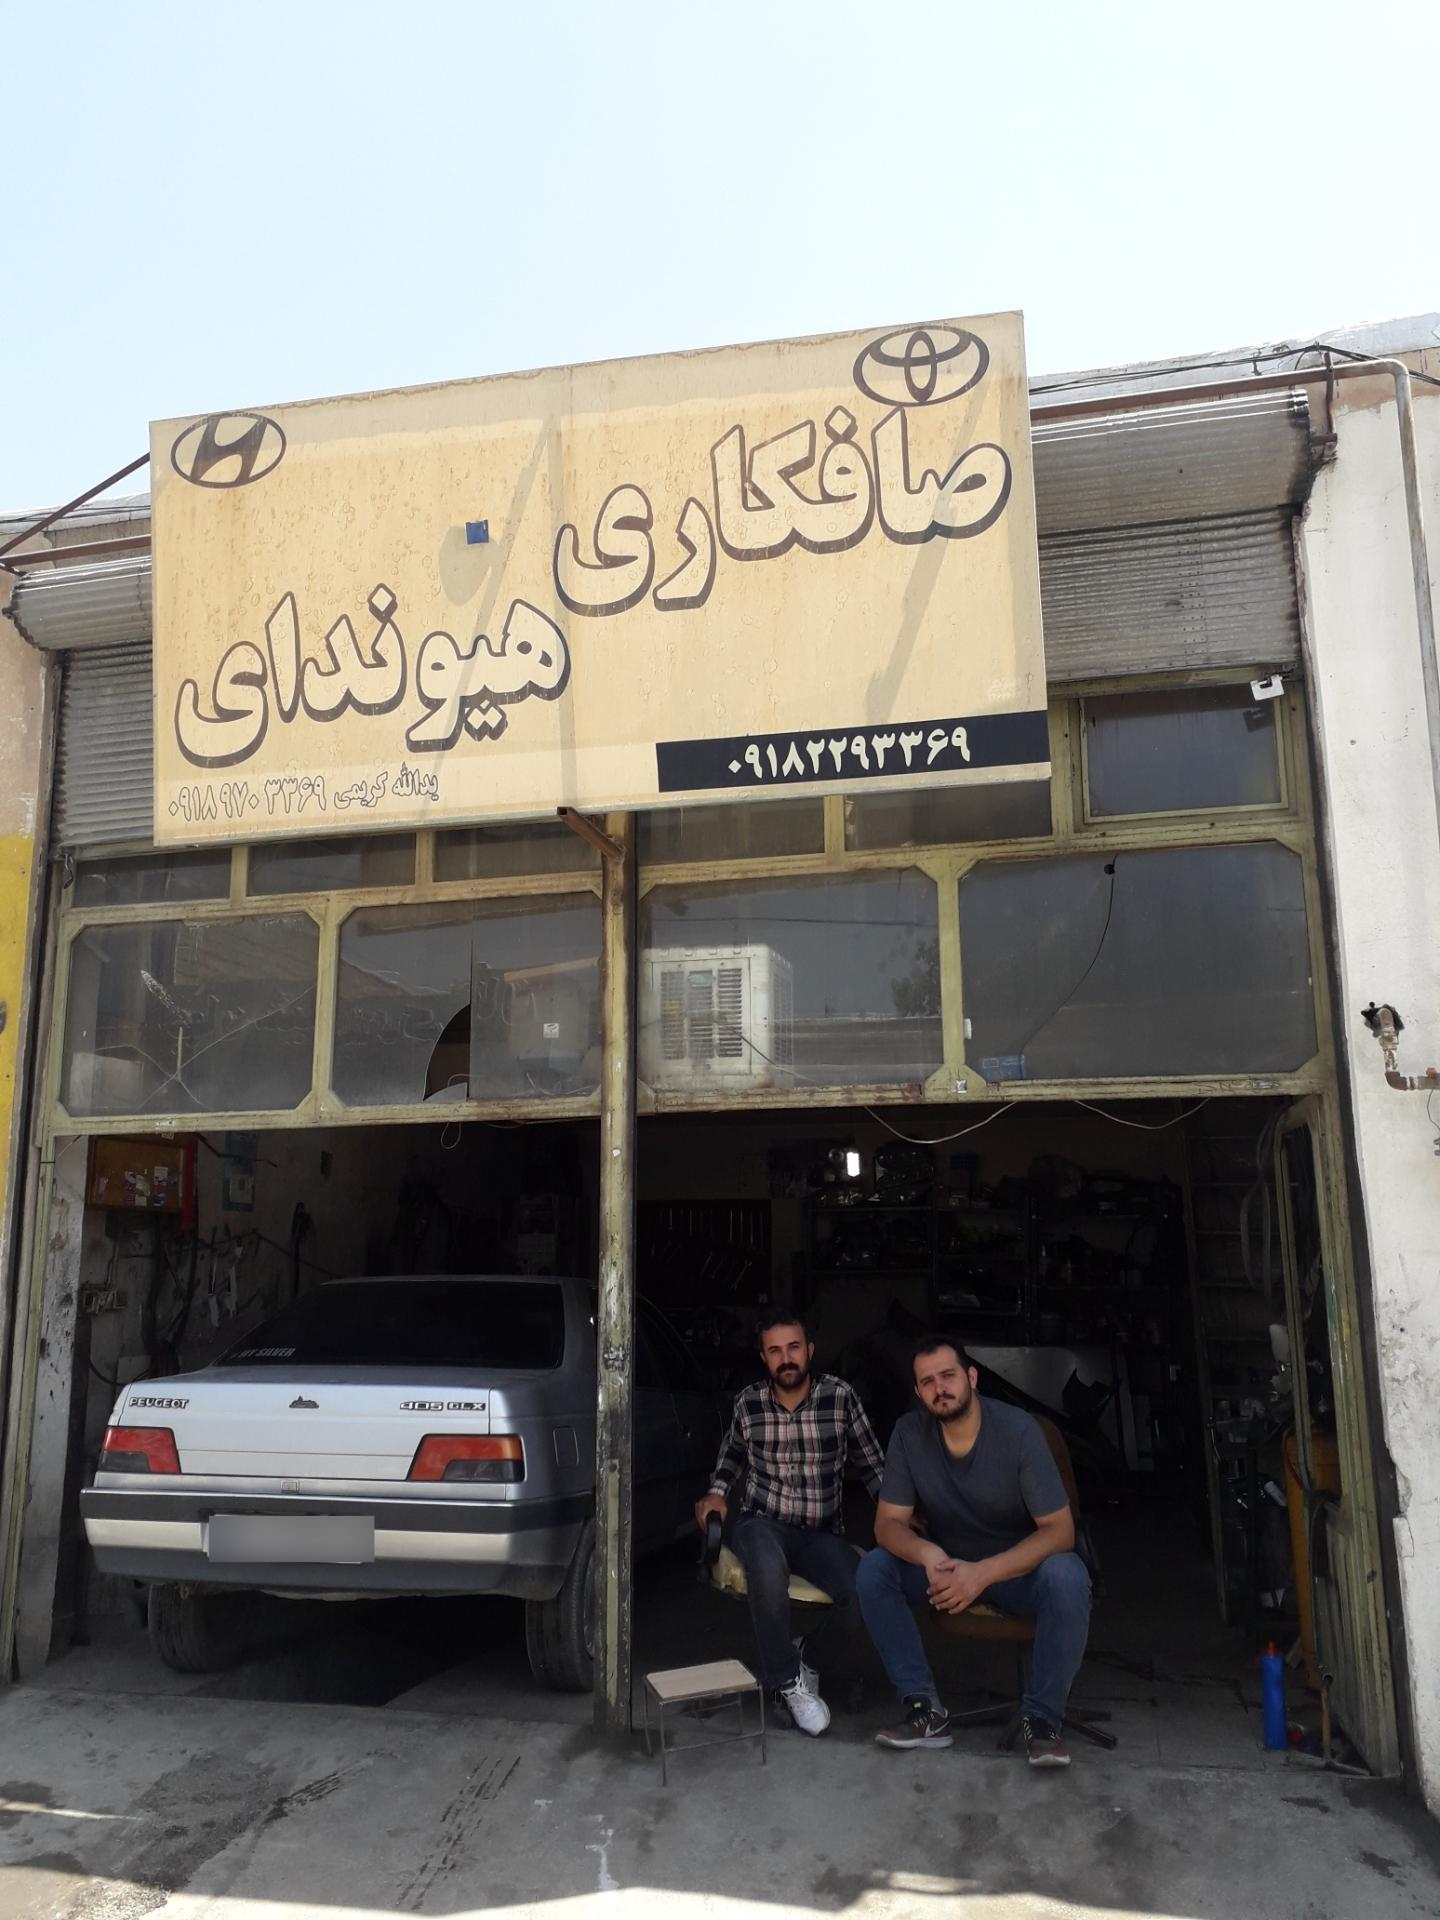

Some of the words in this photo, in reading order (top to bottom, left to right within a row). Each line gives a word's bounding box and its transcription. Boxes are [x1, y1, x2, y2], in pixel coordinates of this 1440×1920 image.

[554, 405, 1012, 617] صافکاری
[175, 583, 572, 768] هیوندای
[727, 725, 972, 780] ۰۹۱۸۲۲۹۳۳۶۹
[333, 770, 389, 810] کریمی
[391, 761, 440, 802] یدالله
[128, 1397, 189, 1409] PEUGEOT
[400, 1401, 444, 1411] 405
[447, 1402, 486, 1411] GLX
